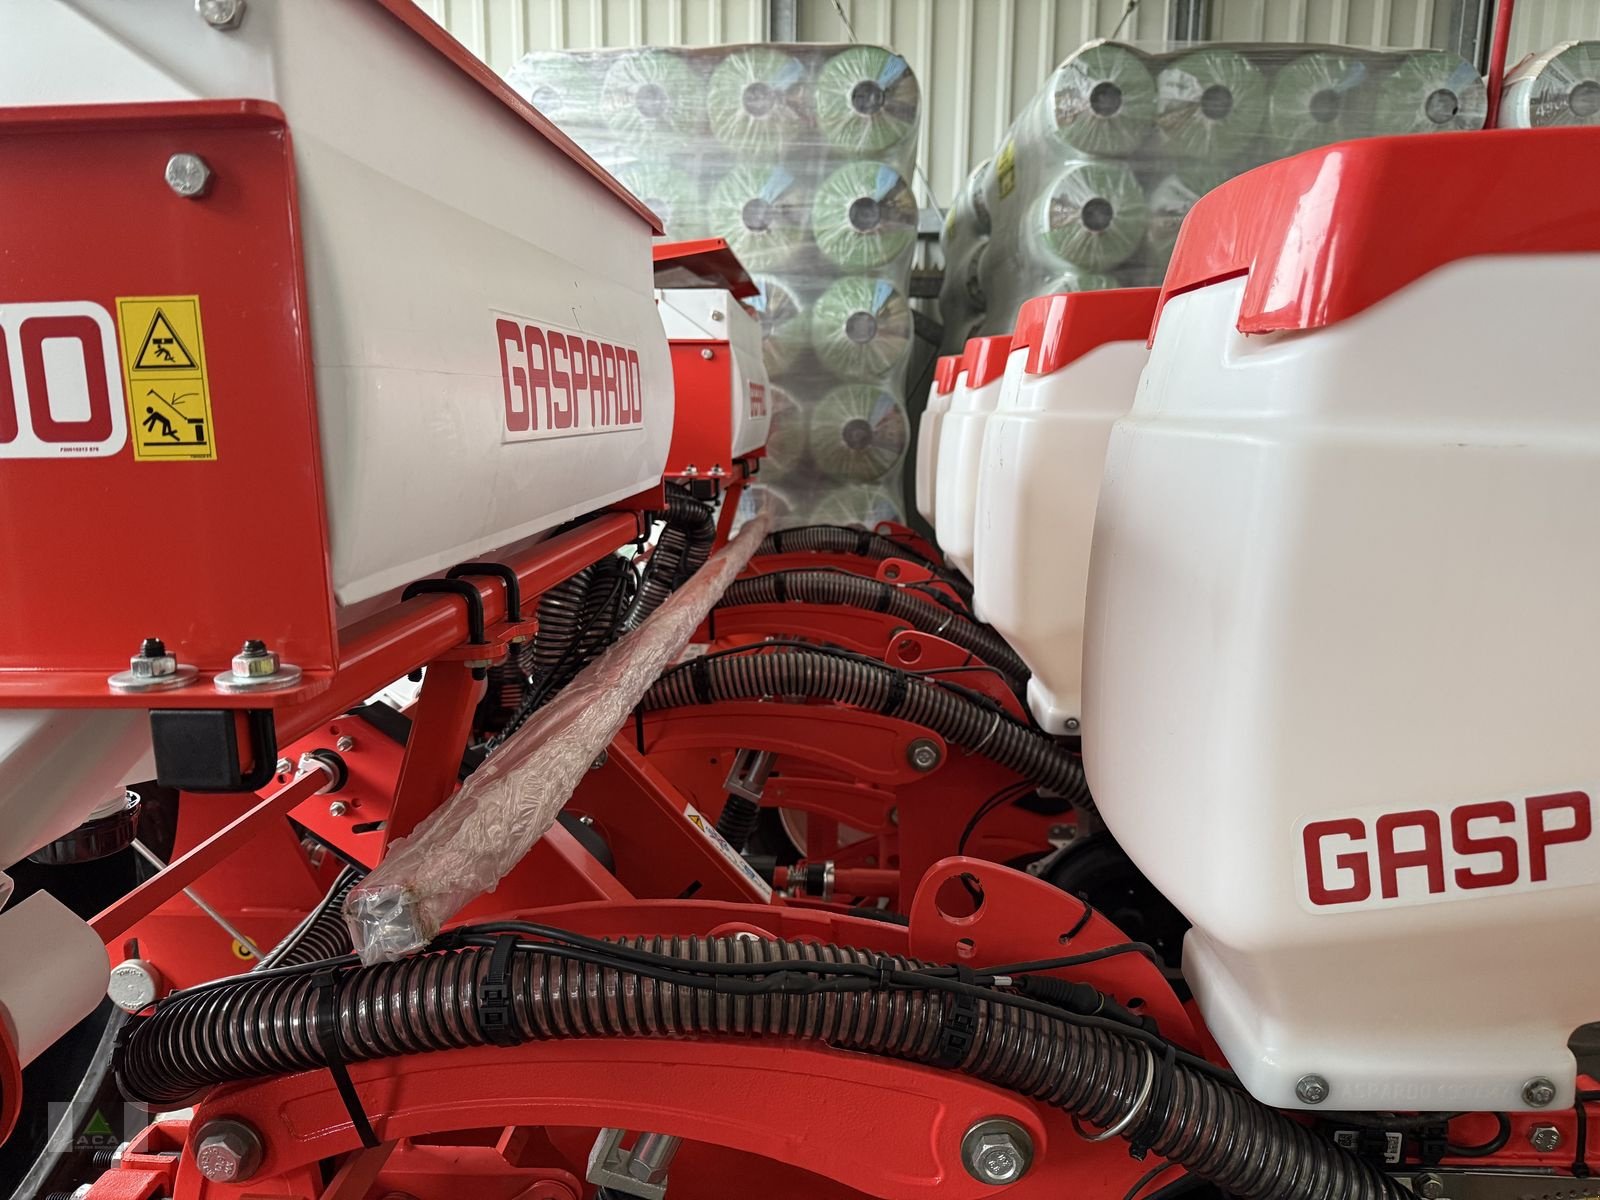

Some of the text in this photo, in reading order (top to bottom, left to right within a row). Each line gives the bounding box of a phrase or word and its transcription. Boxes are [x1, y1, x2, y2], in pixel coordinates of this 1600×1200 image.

[0, 315, 113, 444] O
[496, 318, 643, 432] GASPARDO
[1303, 791, 1592, 906] GASP
